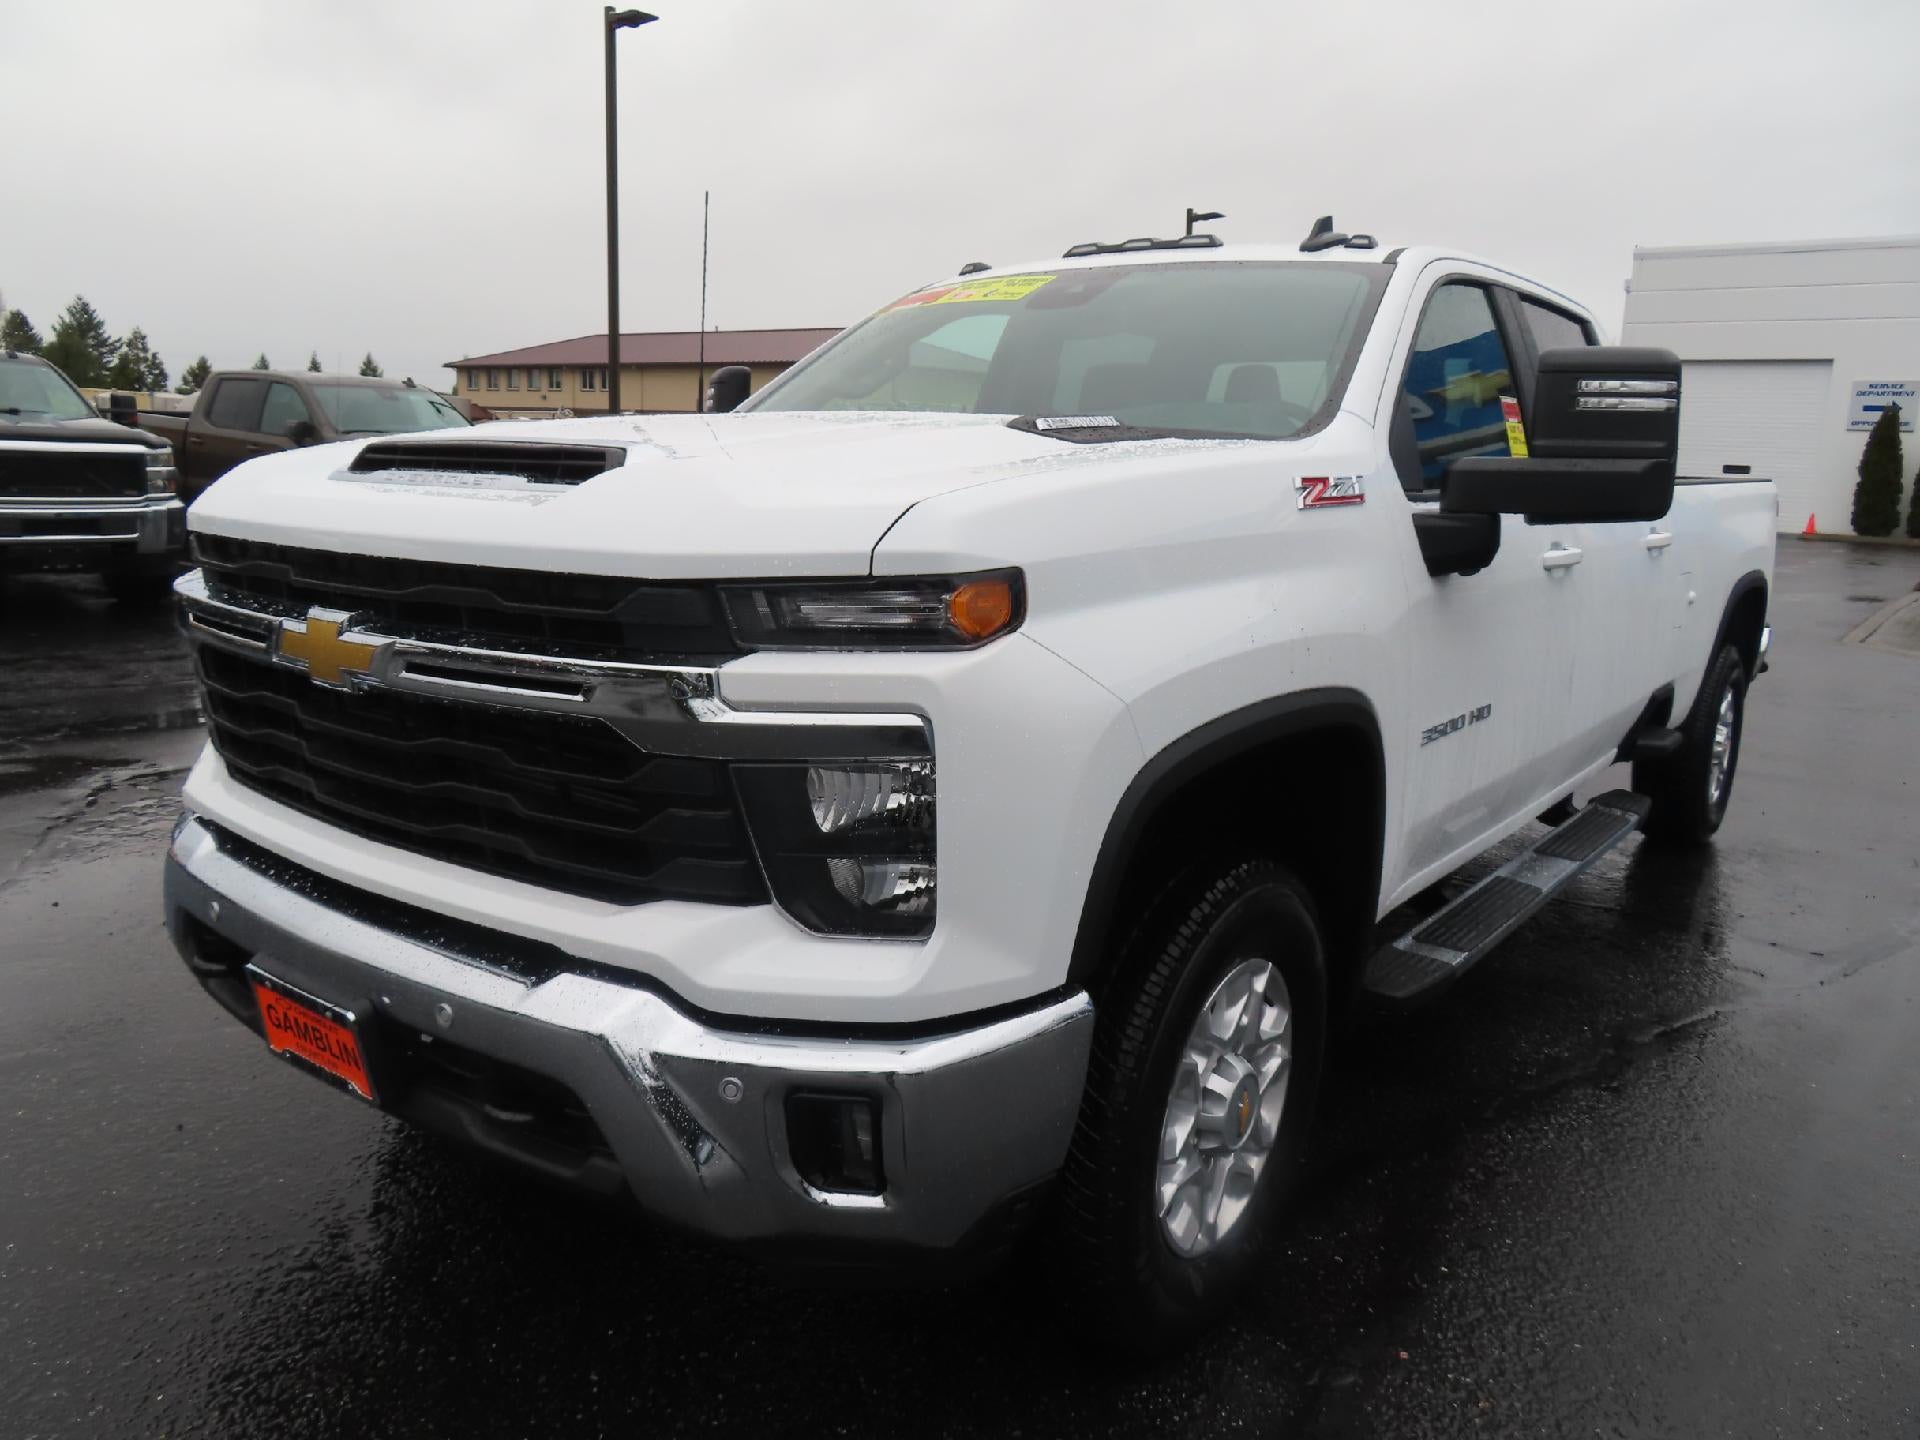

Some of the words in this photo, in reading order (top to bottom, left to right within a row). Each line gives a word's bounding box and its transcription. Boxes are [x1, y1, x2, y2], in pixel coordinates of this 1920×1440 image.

[1294, 475, 1366, 510] Z71
[1468, 703, 1492, 726] HD
[266, 1002, 362, 1072] GAMBLIN
